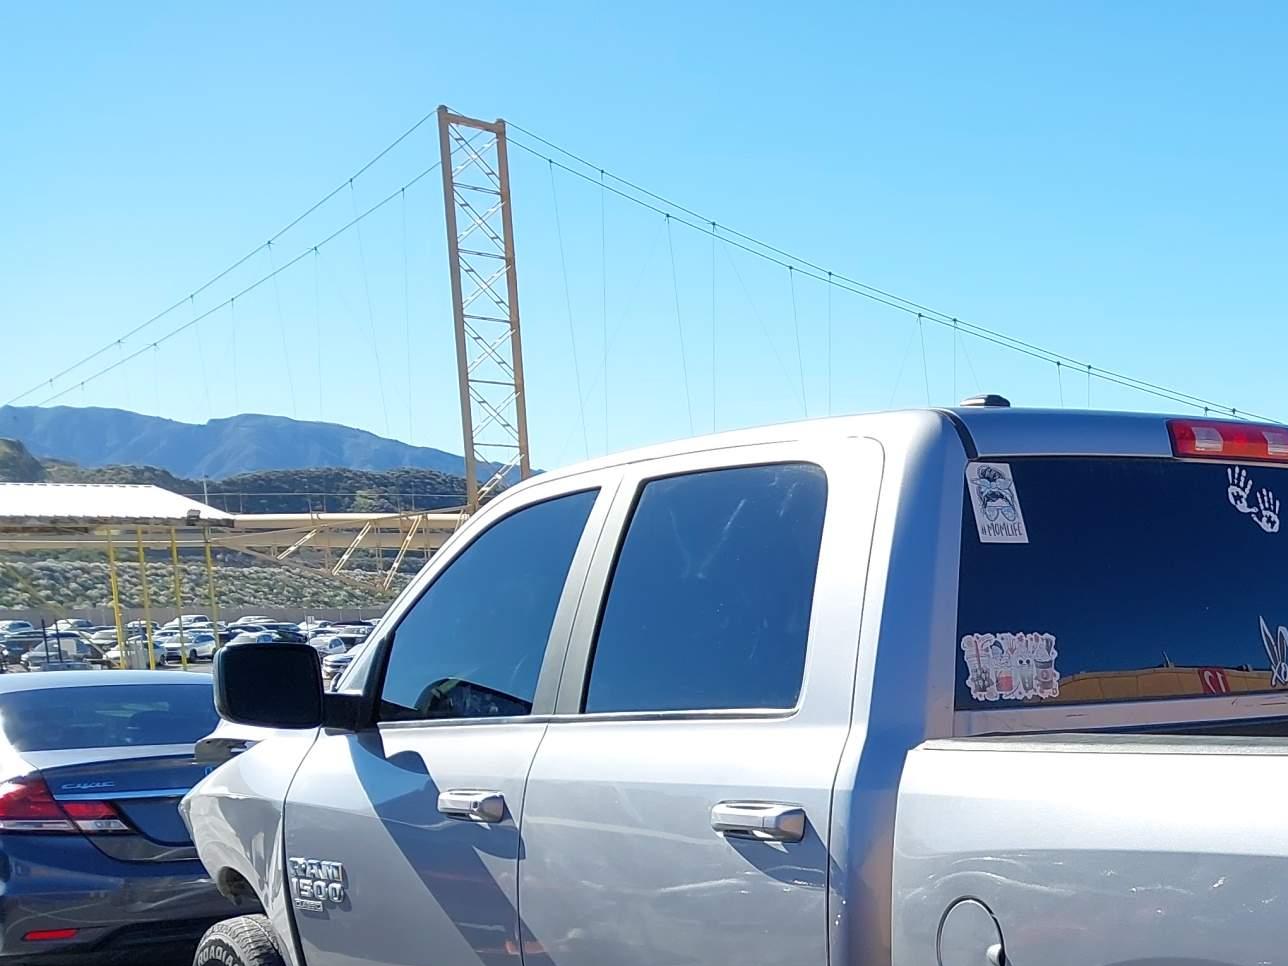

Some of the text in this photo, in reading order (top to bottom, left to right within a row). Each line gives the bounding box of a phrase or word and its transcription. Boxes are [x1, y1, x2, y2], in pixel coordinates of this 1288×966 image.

[982, 522, 1024, 537] #MOMLIFE
[289, 857, 343, 882] RAM
[291, 877, 344, 902] 1500
